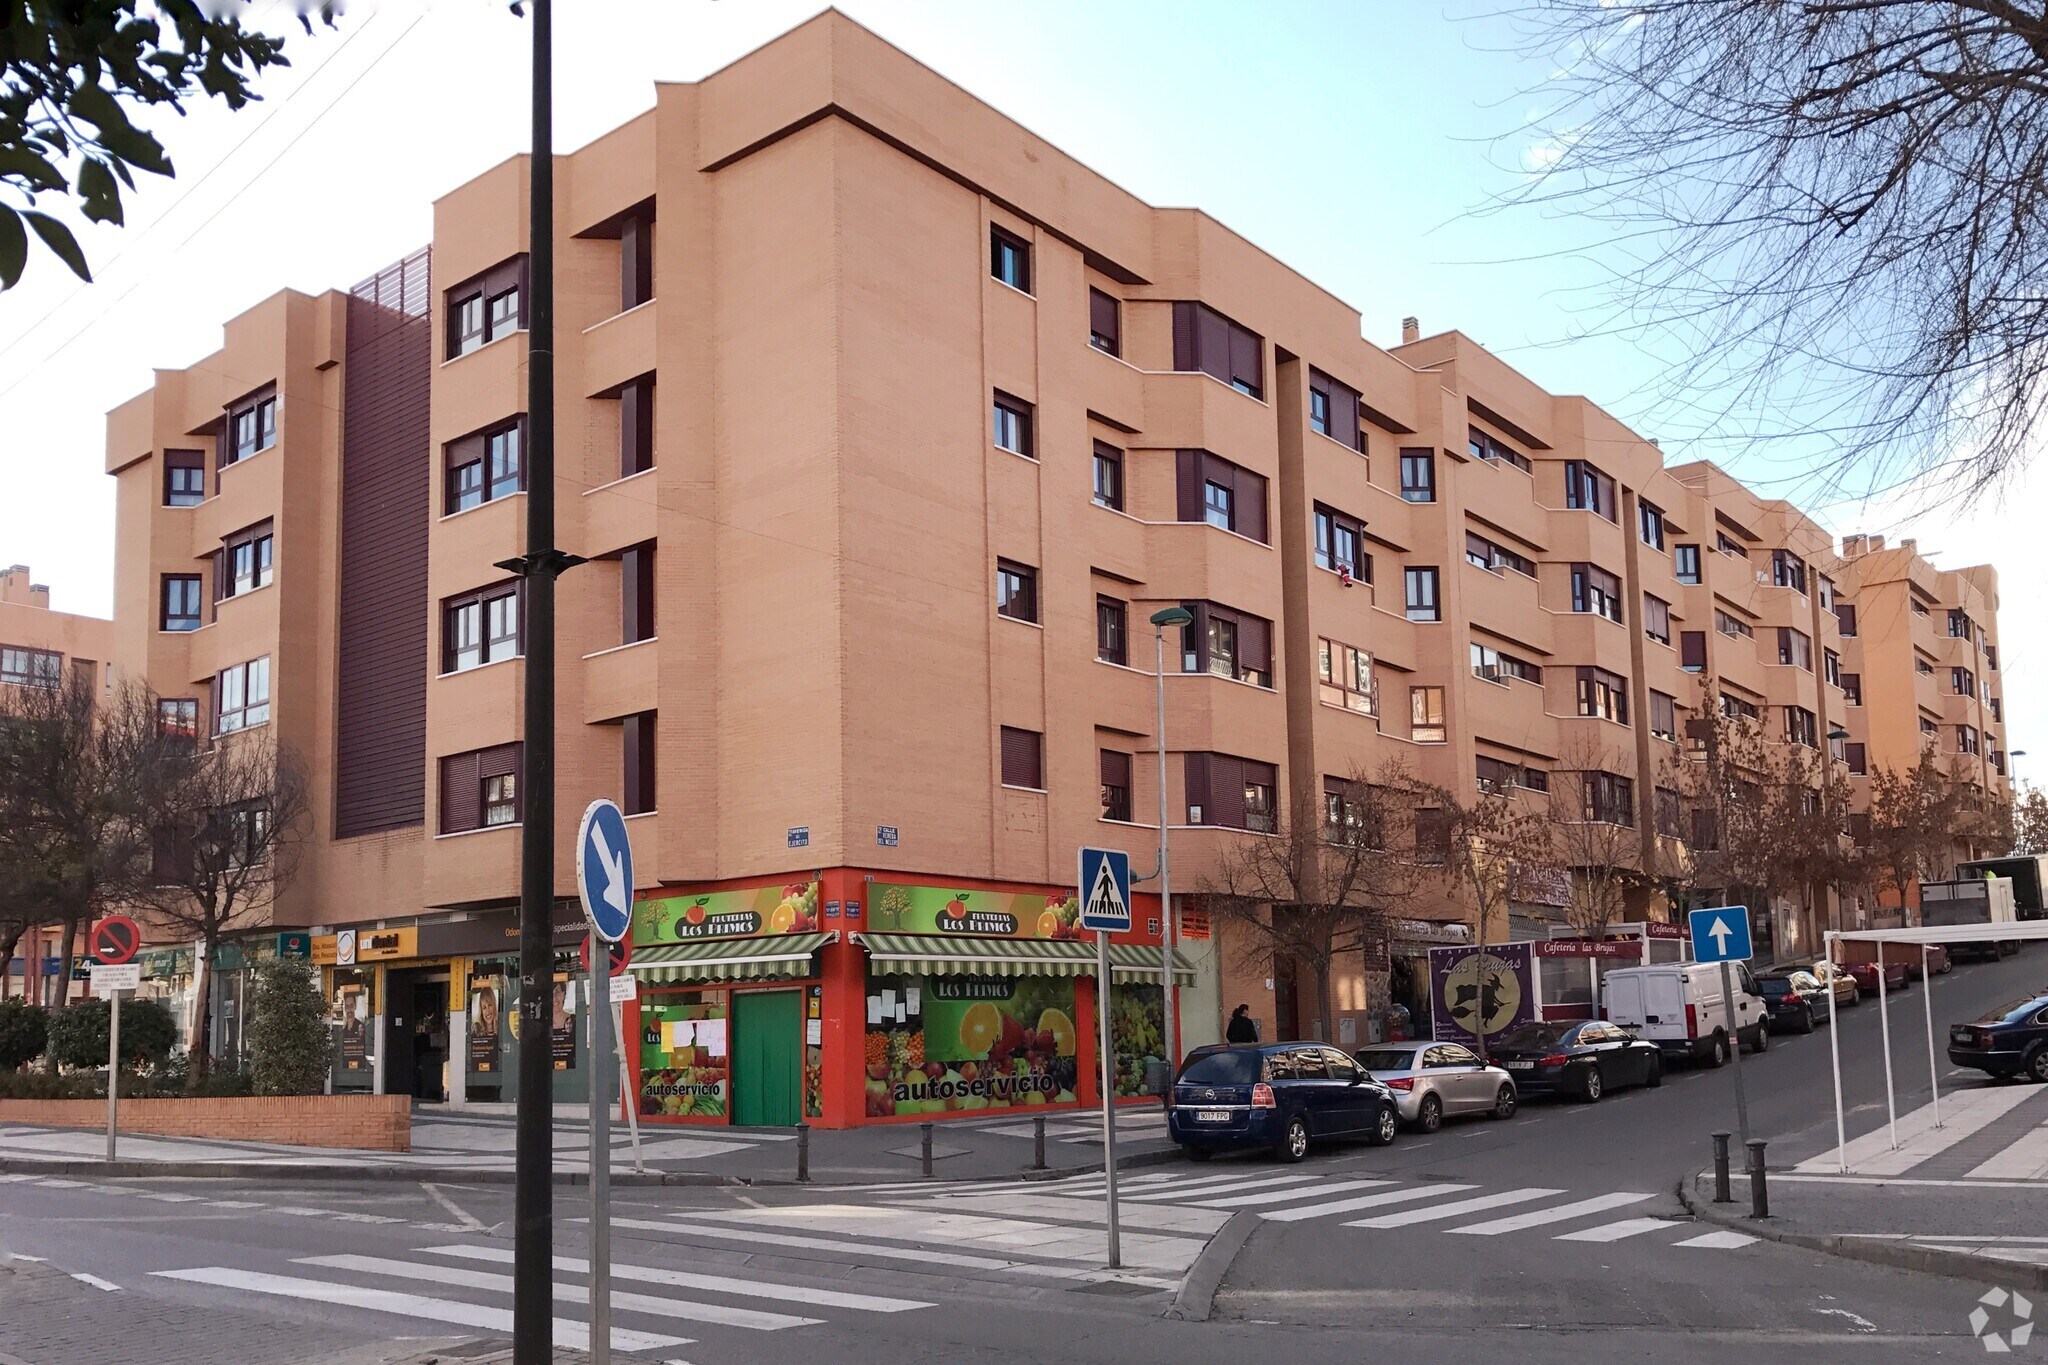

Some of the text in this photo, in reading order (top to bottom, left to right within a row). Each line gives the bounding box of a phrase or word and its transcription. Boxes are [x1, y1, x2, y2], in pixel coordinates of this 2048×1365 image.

[712, 912, 754, 924] FRUTERIAS
[972, 912, 1011, 922] FRUTERIAS
[682, 921, 754, 937] LOS PRIMOS
[943, 918, 1012, 932] LOS PRIMOS
[1652, 924, 1689, 936] Cafetería las
[1438, 944, 1521, 955] CAFEERIA
[1544, 941, 1616, 955] Cafetería las Brujas
[1440, 957, 1469, 975] Las
[939, 982, 1009, 997] LOS PRIMOS
[646, 1081, 720, 1097] autoservicio
[893, 1070, 1054, 1101] autoservicio
[1200, 1112, 1228, 1120] 9017 FPG
